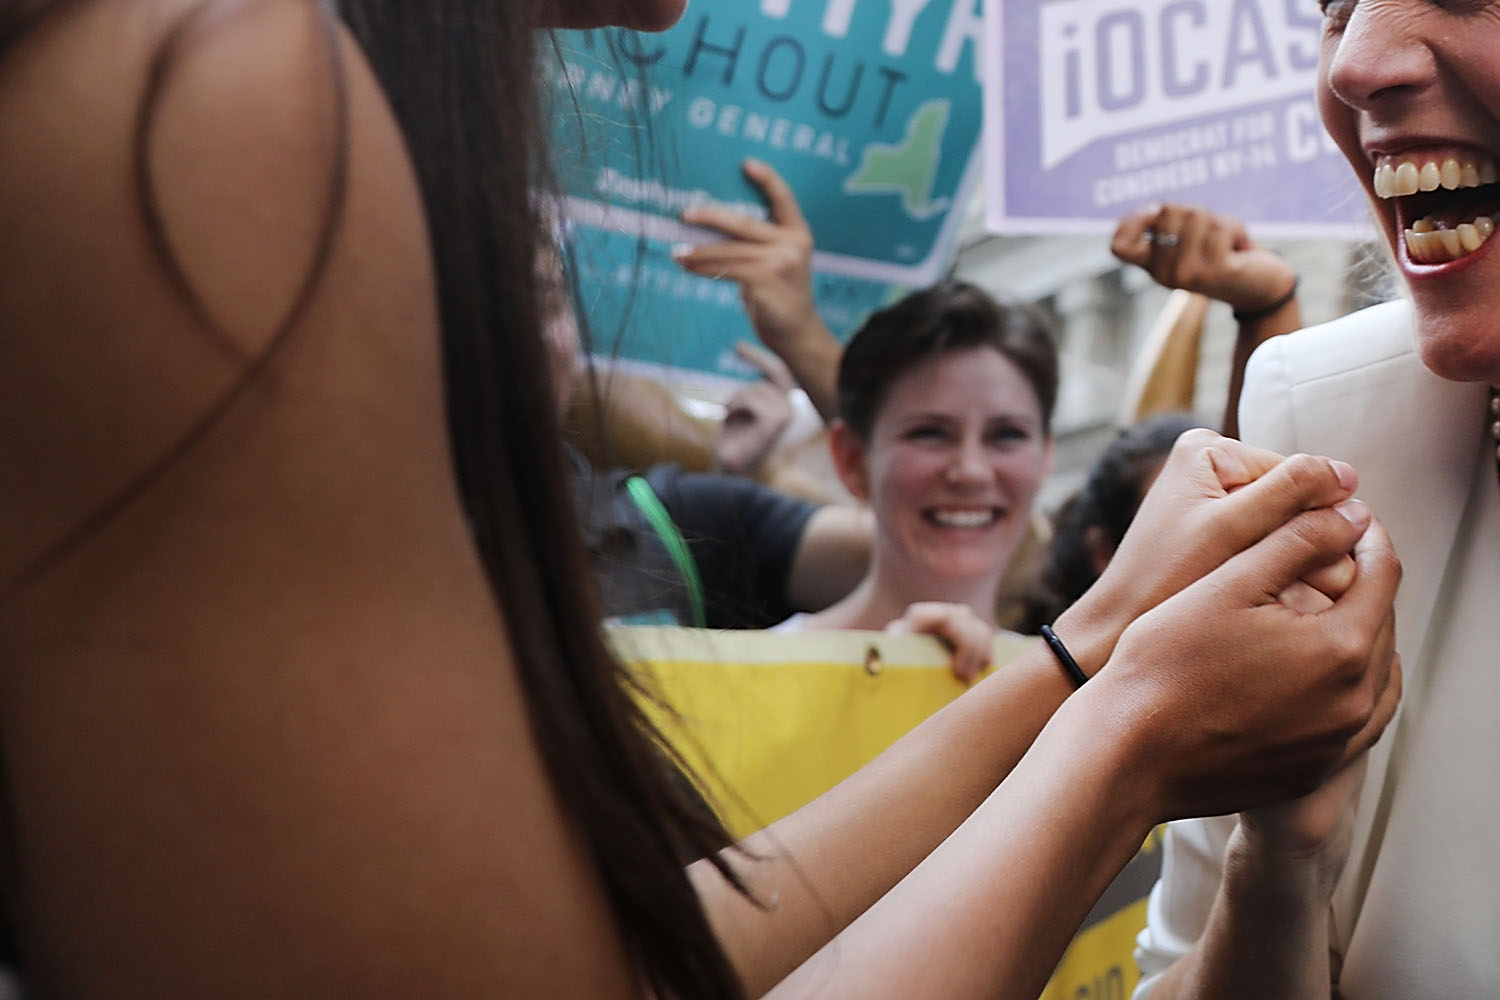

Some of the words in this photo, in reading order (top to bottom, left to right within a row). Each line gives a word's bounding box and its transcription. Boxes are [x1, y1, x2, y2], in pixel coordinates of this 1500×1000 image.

[687, 96, 851, 165] GENERAL
[1114, 121, 1227, 171] DEMOCRAT
[1233, 112, 1275, 142] FOR
[1093, 157, 1208, 206] CONGRESS
